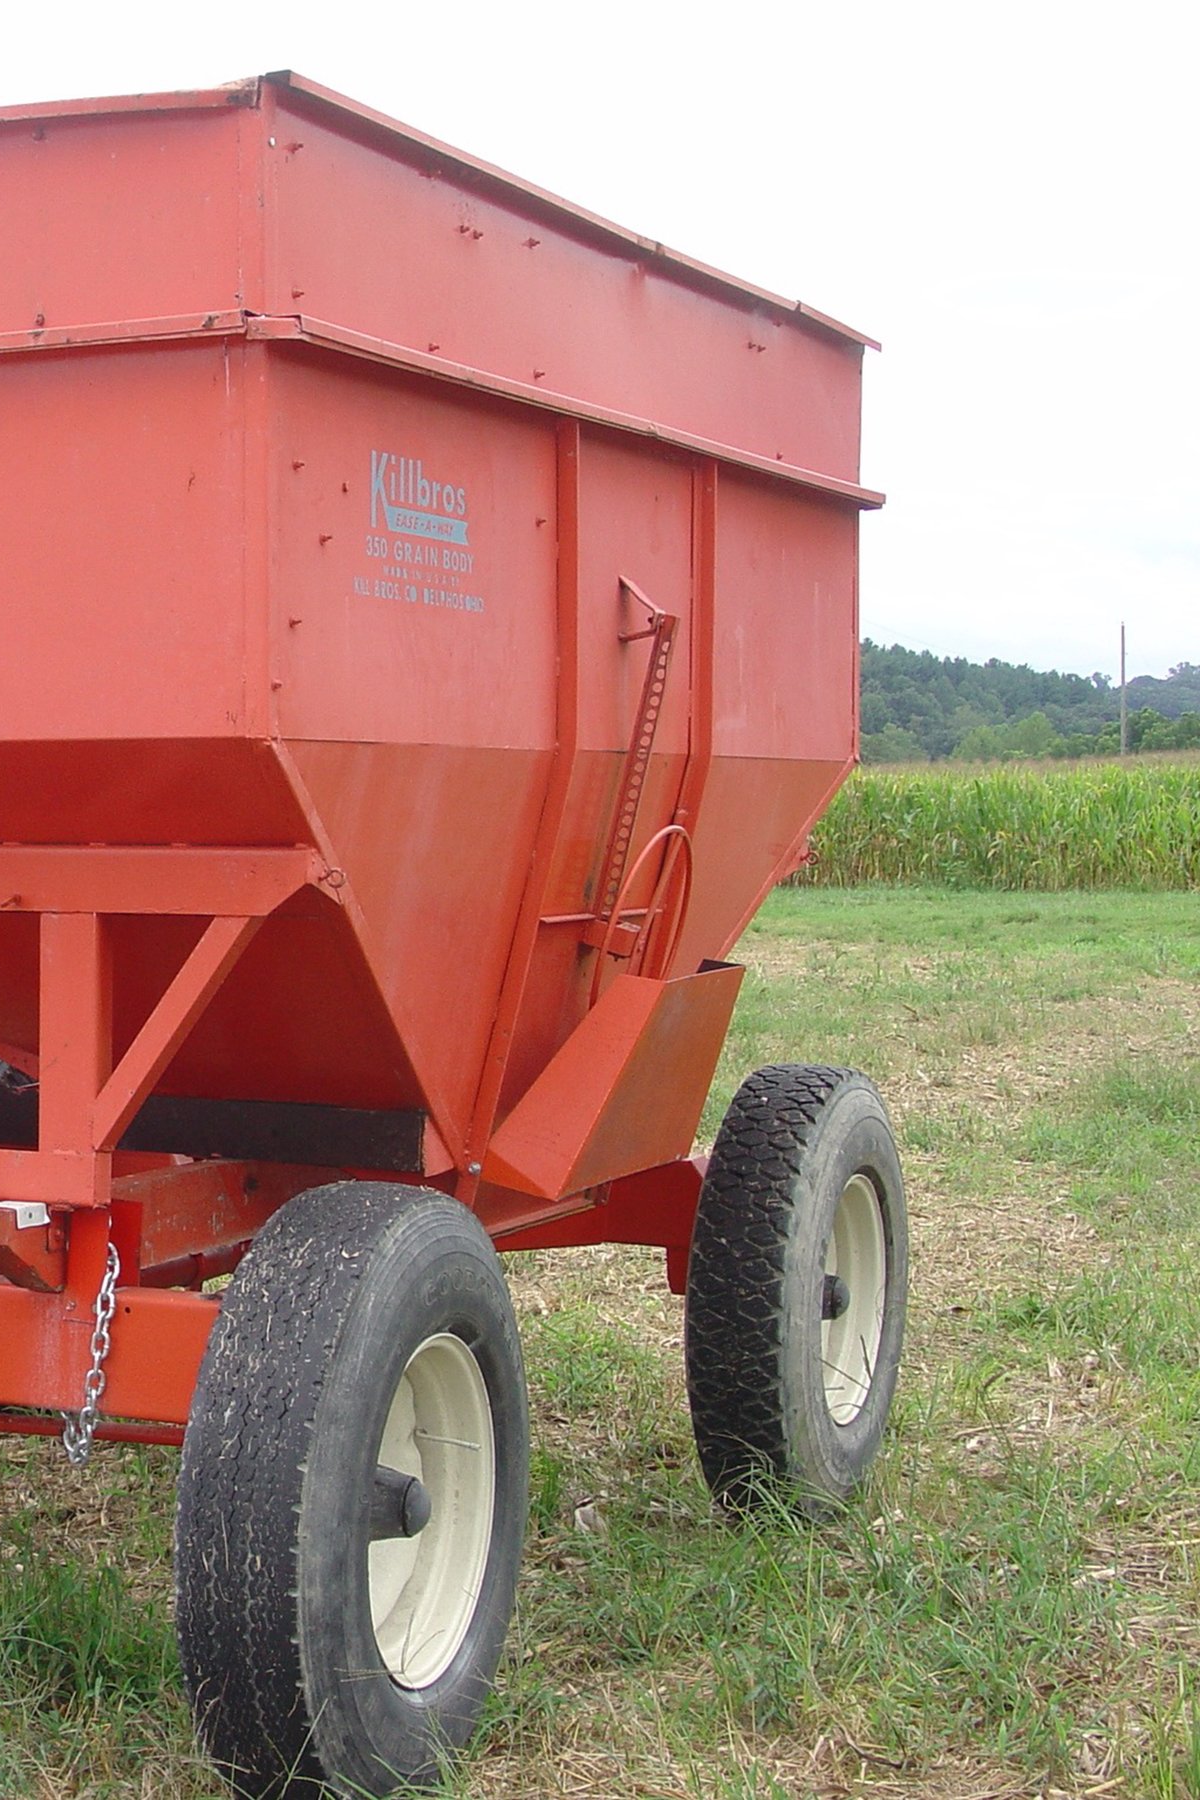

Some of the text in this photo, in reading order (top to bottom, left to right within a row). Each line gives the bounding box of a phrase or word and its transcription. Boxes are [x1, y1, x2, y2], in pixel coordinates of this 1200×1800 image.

[371, 450, 465, 528] Killbros
[366, 535, 474, 573] 350 GRAIN BODY
[354, 576, 370, 596] KILL
[423, 587, 464, 610] DELPHOS
